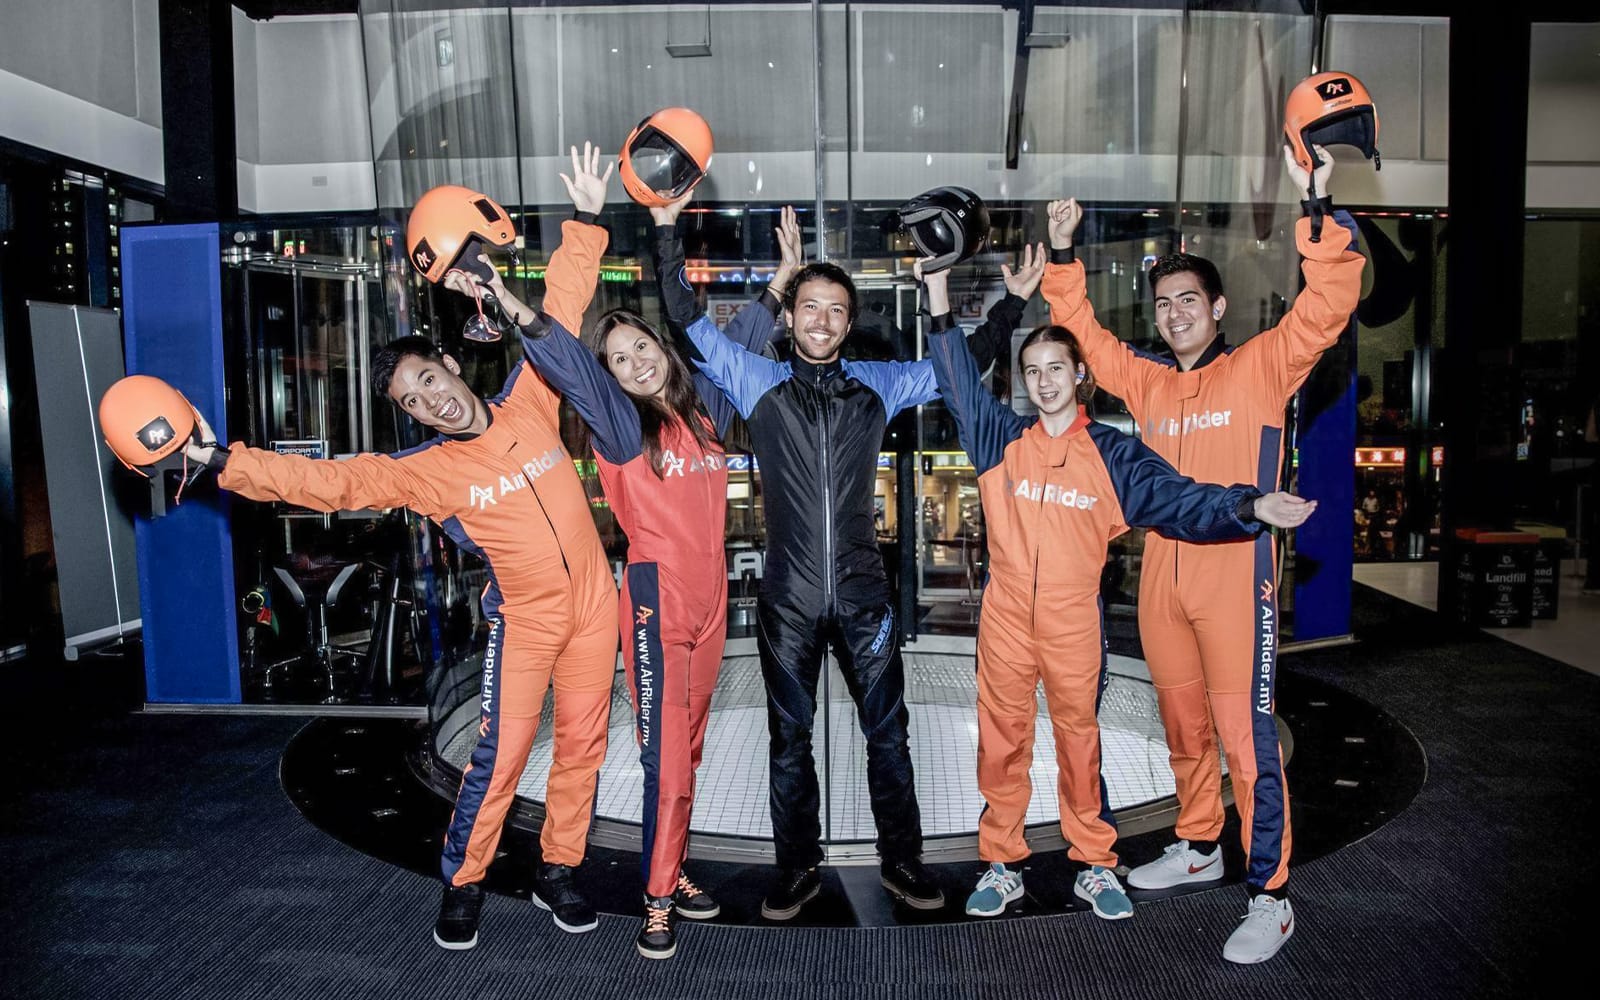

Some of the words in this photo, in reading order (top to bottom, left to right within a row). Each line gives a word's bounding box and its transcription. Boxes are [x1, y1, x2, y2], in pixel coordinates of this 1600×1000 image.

[1014, 479, 1098, 511] AirRider
[1486, 572, 1526, 584] Landfill
[1534, 567, 1553, 577] xed
[1257, 605, 1274, 715] AirRider.my
